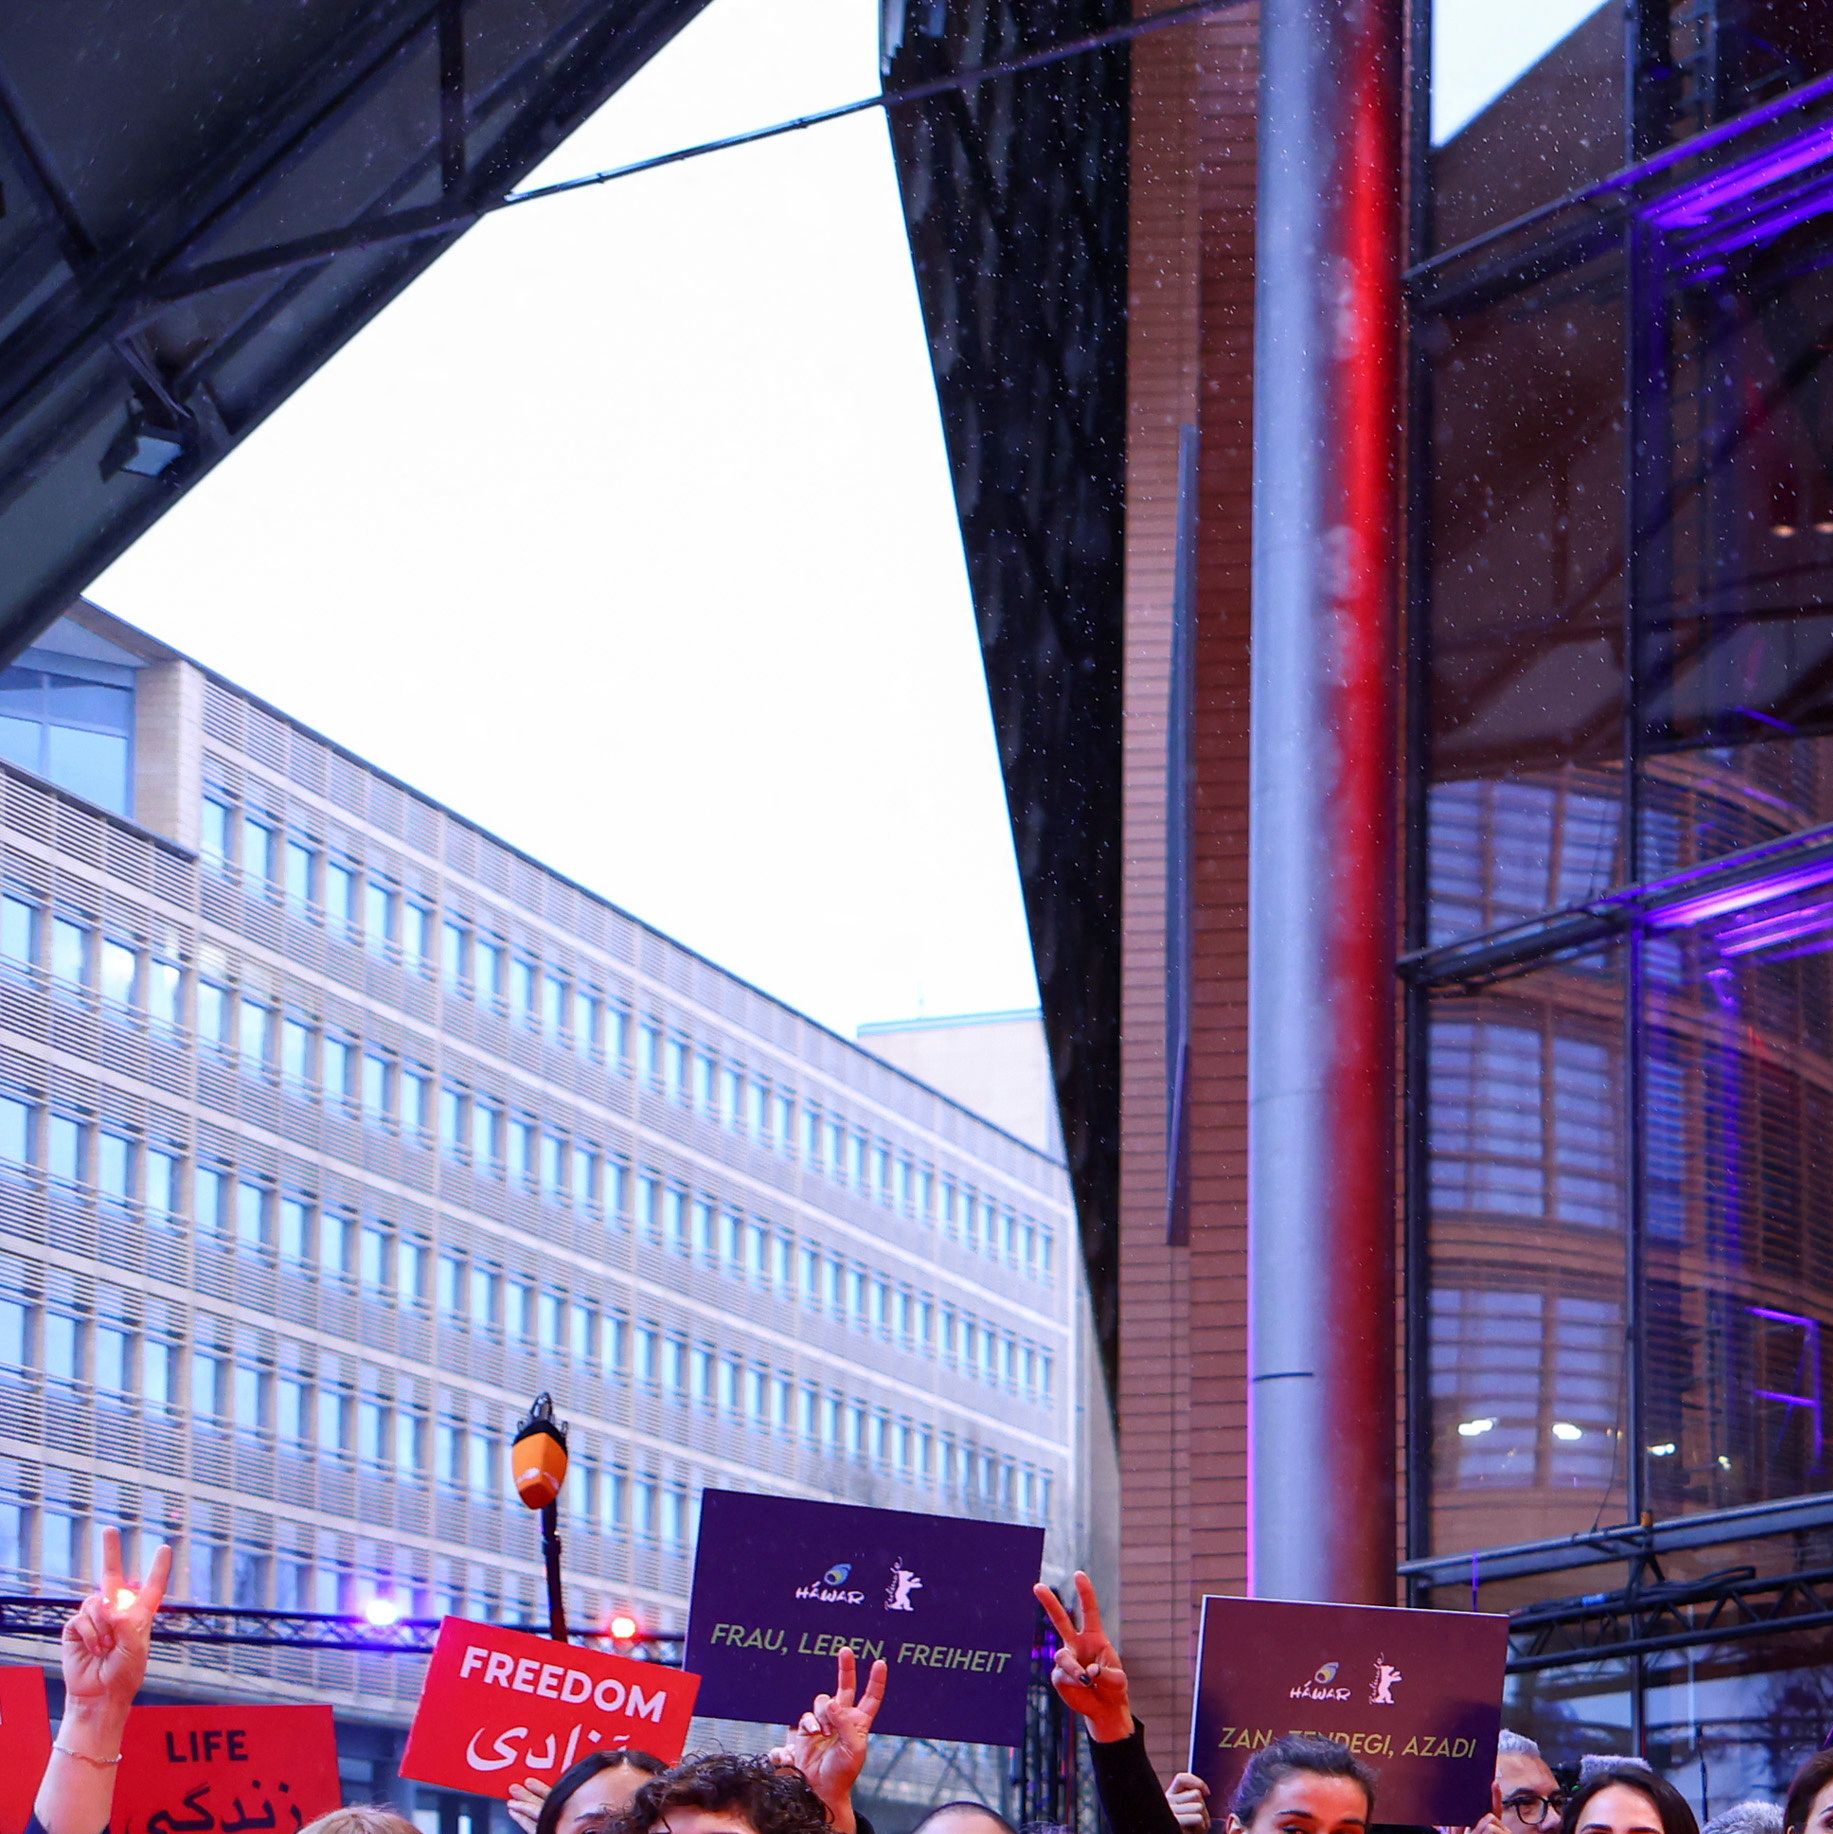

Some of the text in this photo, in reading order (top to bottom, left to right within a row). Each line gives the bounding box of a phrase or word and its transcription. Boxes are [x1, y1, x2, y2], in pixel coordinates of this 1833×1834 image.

[710, 1623, 789, 1654] FRAU,
[897, 1643, 1012, 1674] FREIHEIT
[460, 1646, 667, 1723] FREEDOM
[166, 1730, 249, 1763] LIFE
[1401, 1735, 1477, 1759] AZADI
